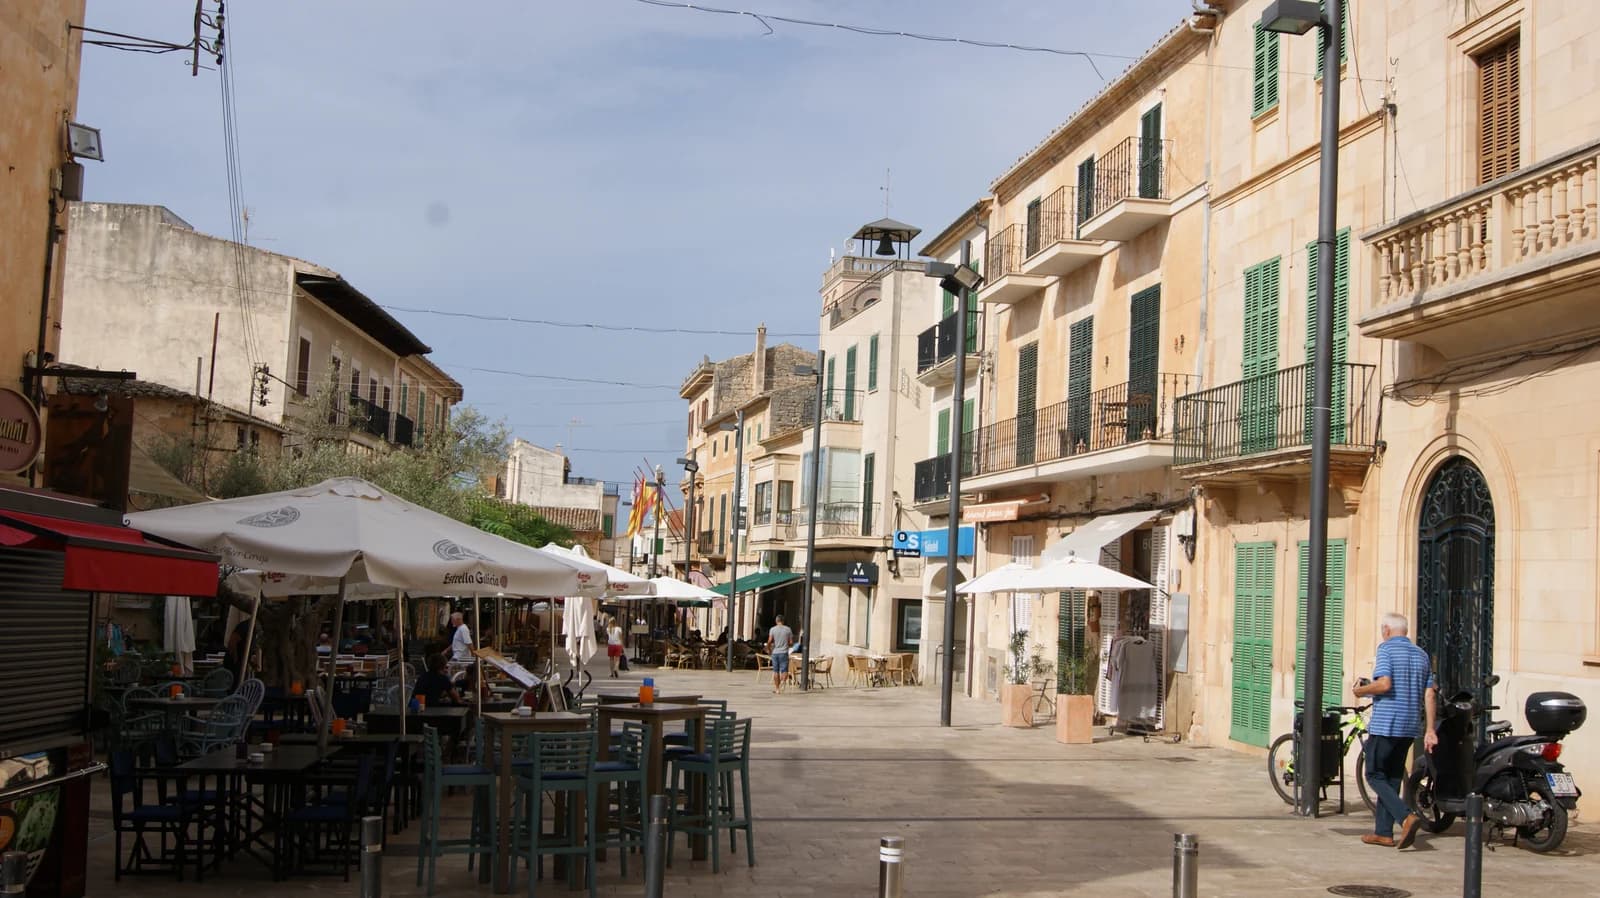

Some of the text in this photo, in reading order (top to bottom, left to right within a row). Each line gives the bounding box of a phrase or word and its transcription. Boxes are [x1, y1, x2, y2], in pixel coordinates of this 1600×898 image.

[908, 534, 919, 549] S
[443, 571, 500, 586] Estrella Galicia
